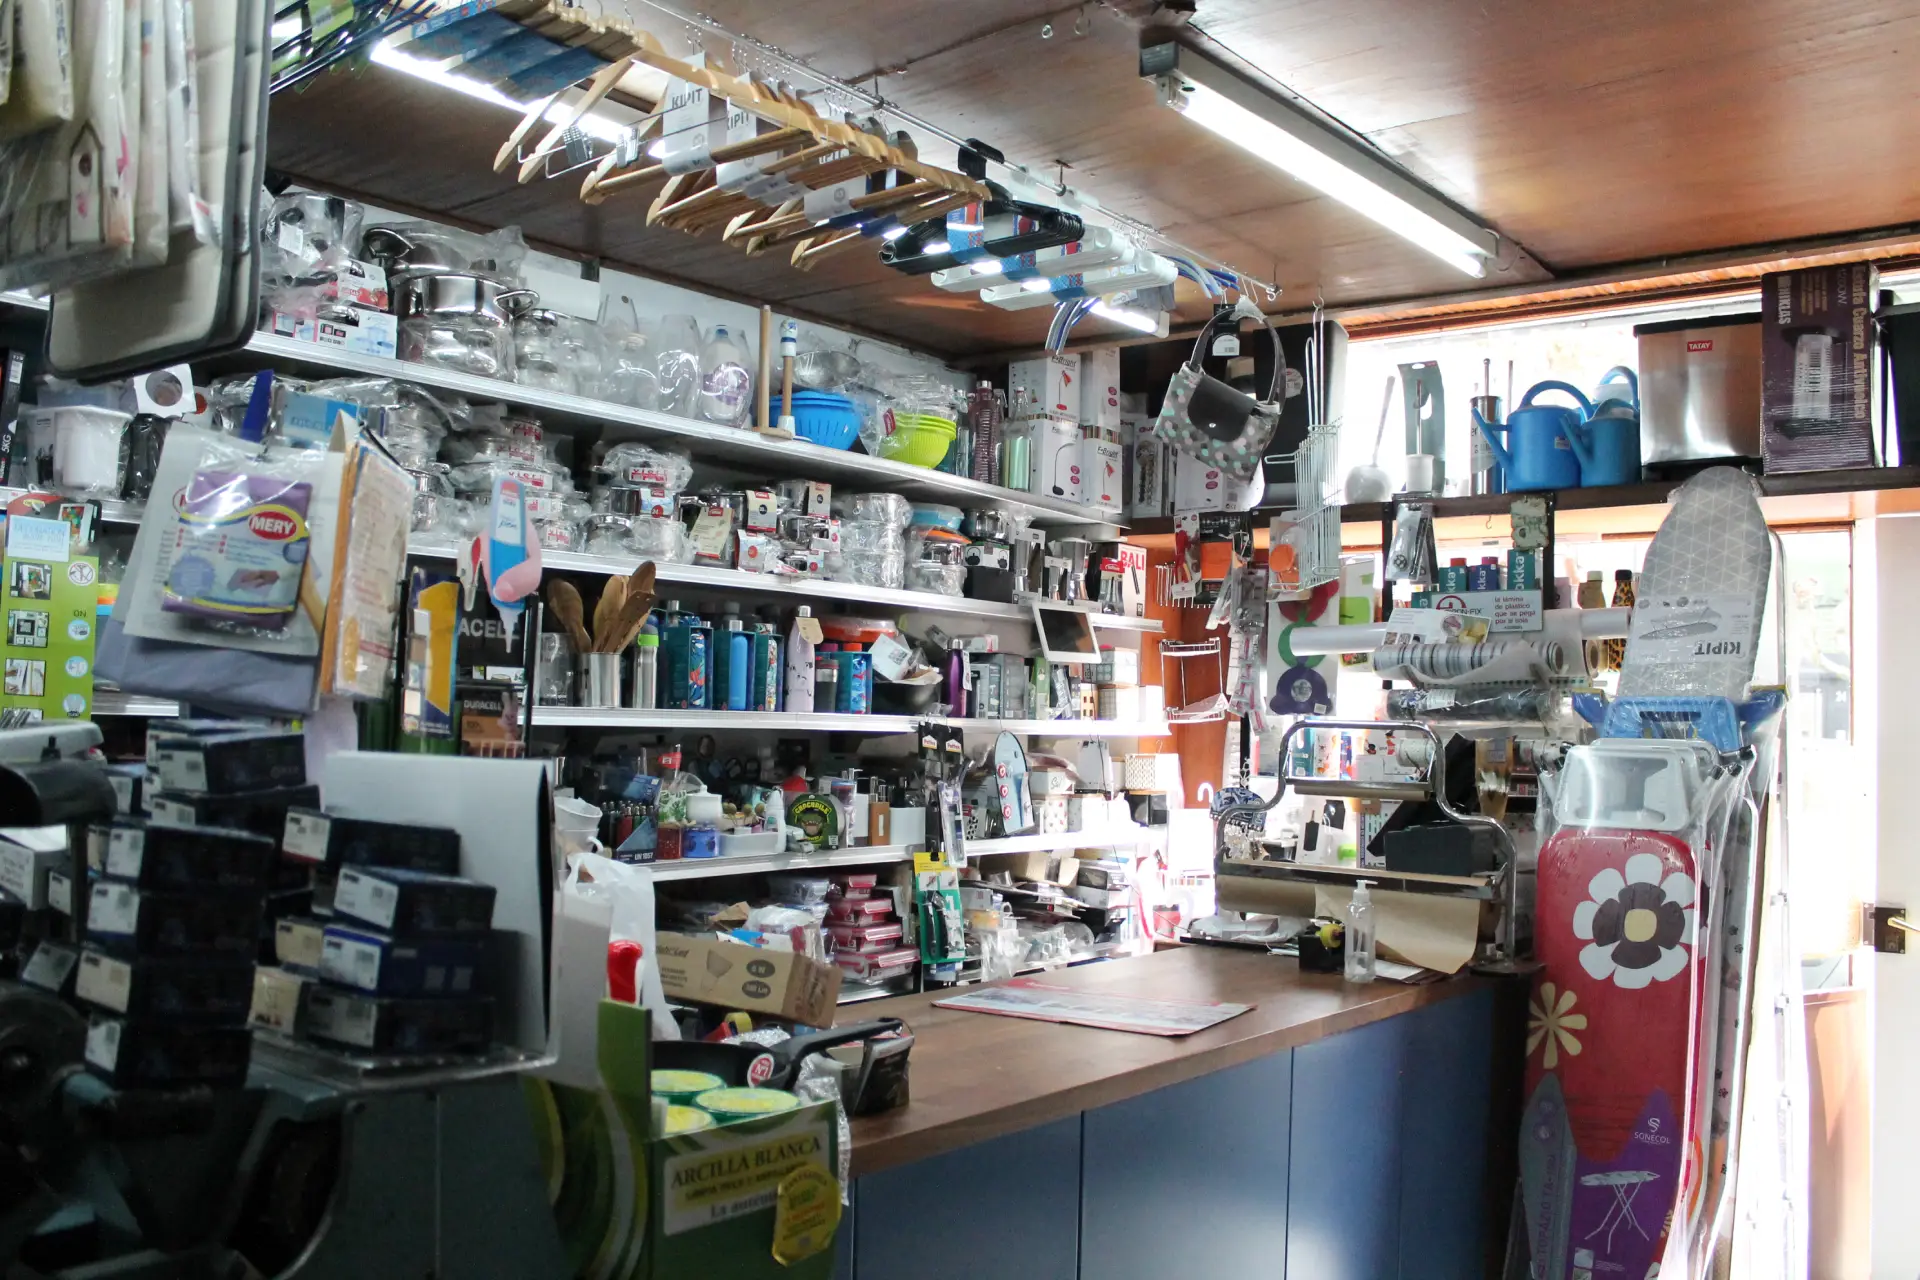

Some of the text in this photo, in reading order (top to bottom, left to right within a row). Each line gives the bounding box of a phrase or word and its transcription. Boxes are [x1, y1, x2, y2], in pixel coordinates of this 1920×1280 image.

[672, 88, 702, 109] KIPIT
[1852, 308, 1867, 350] Cuarzo
[1688, 342, 1711, 350] TATAY
[1, 434, 12, 453] 5KG
[250, 515, 294, 535] MERY
[1120, 549, 1145, 571] BALI
[458, 617, 520, 639] ACEL
[463, 699, 503, 711] DURACELL
[794, 800, 830, 815] CROCODILE
[1634, 1131, 1671, 1145] SONECOL
[671, 1157, 750, 1189] ARCILLA
[752, 1135, 822, 1166] BLANCA
[711, 1204, 726, 1218] La
